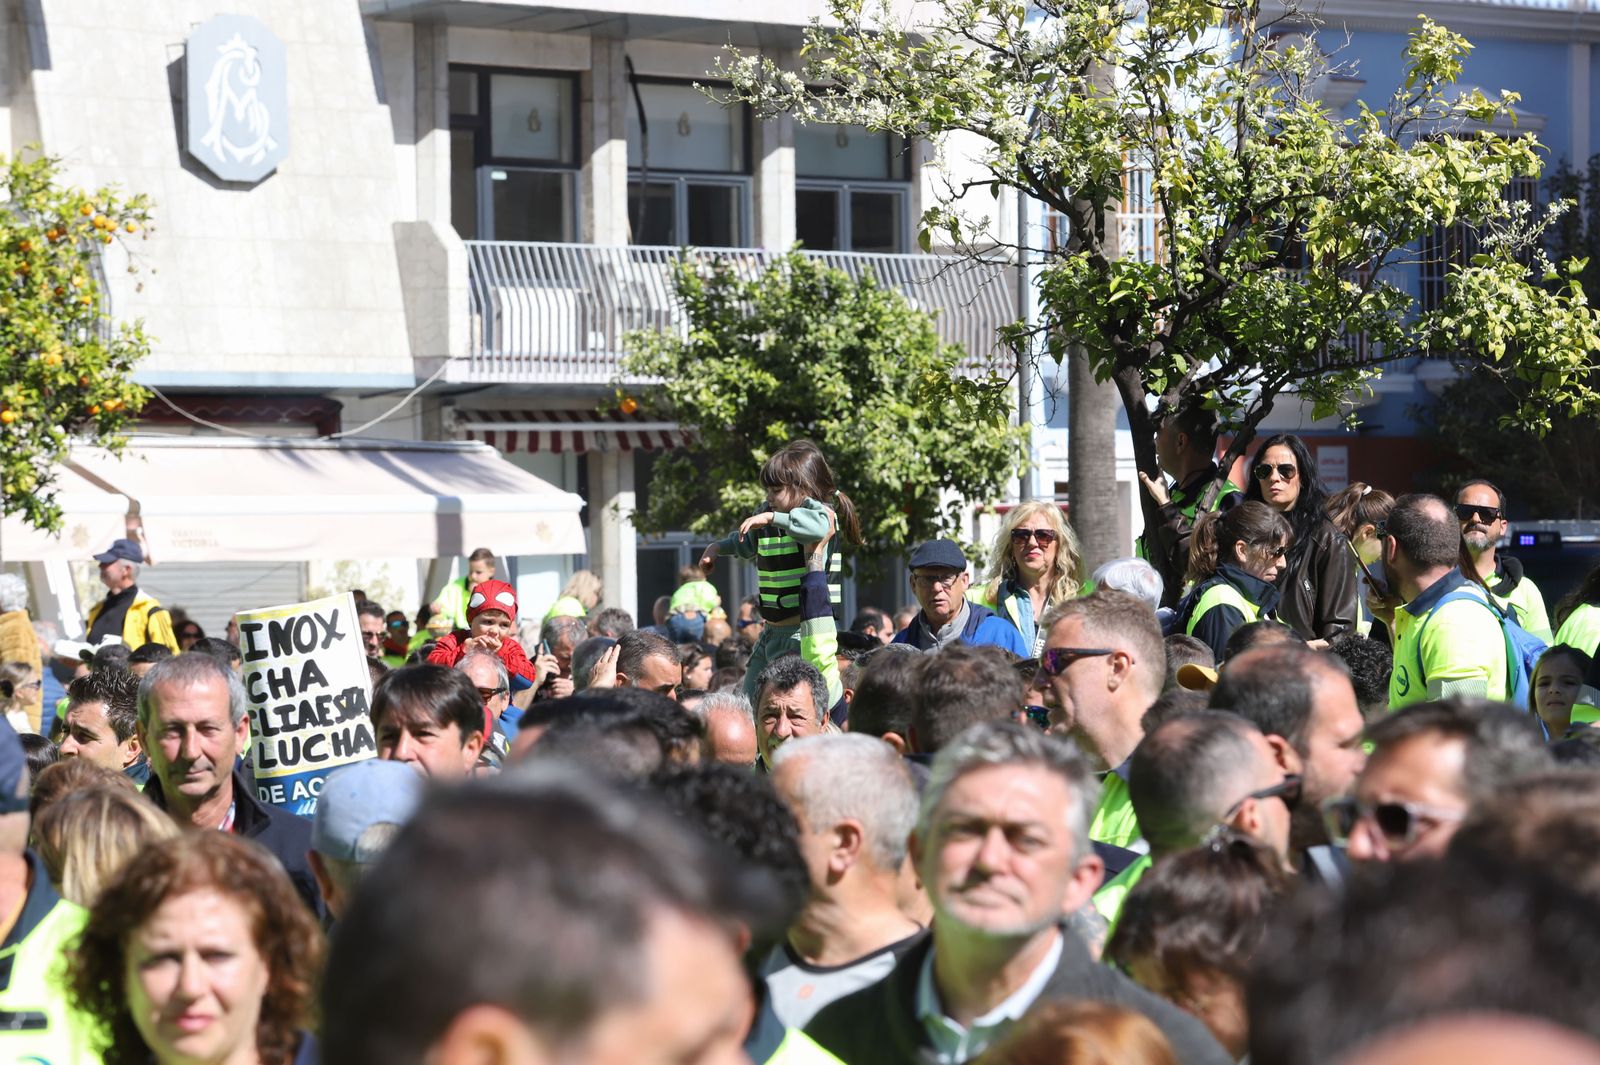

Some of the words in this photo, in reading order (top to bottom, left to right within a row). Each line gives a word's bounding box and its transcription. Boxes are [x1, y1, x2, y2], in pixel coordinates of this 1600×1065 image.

[240, 609, 345, 662] INOX
[248, 659, 330, 704] CHA
[259, 724, 376, 769] LUCHA
[258, 784, 287, 804] DE
